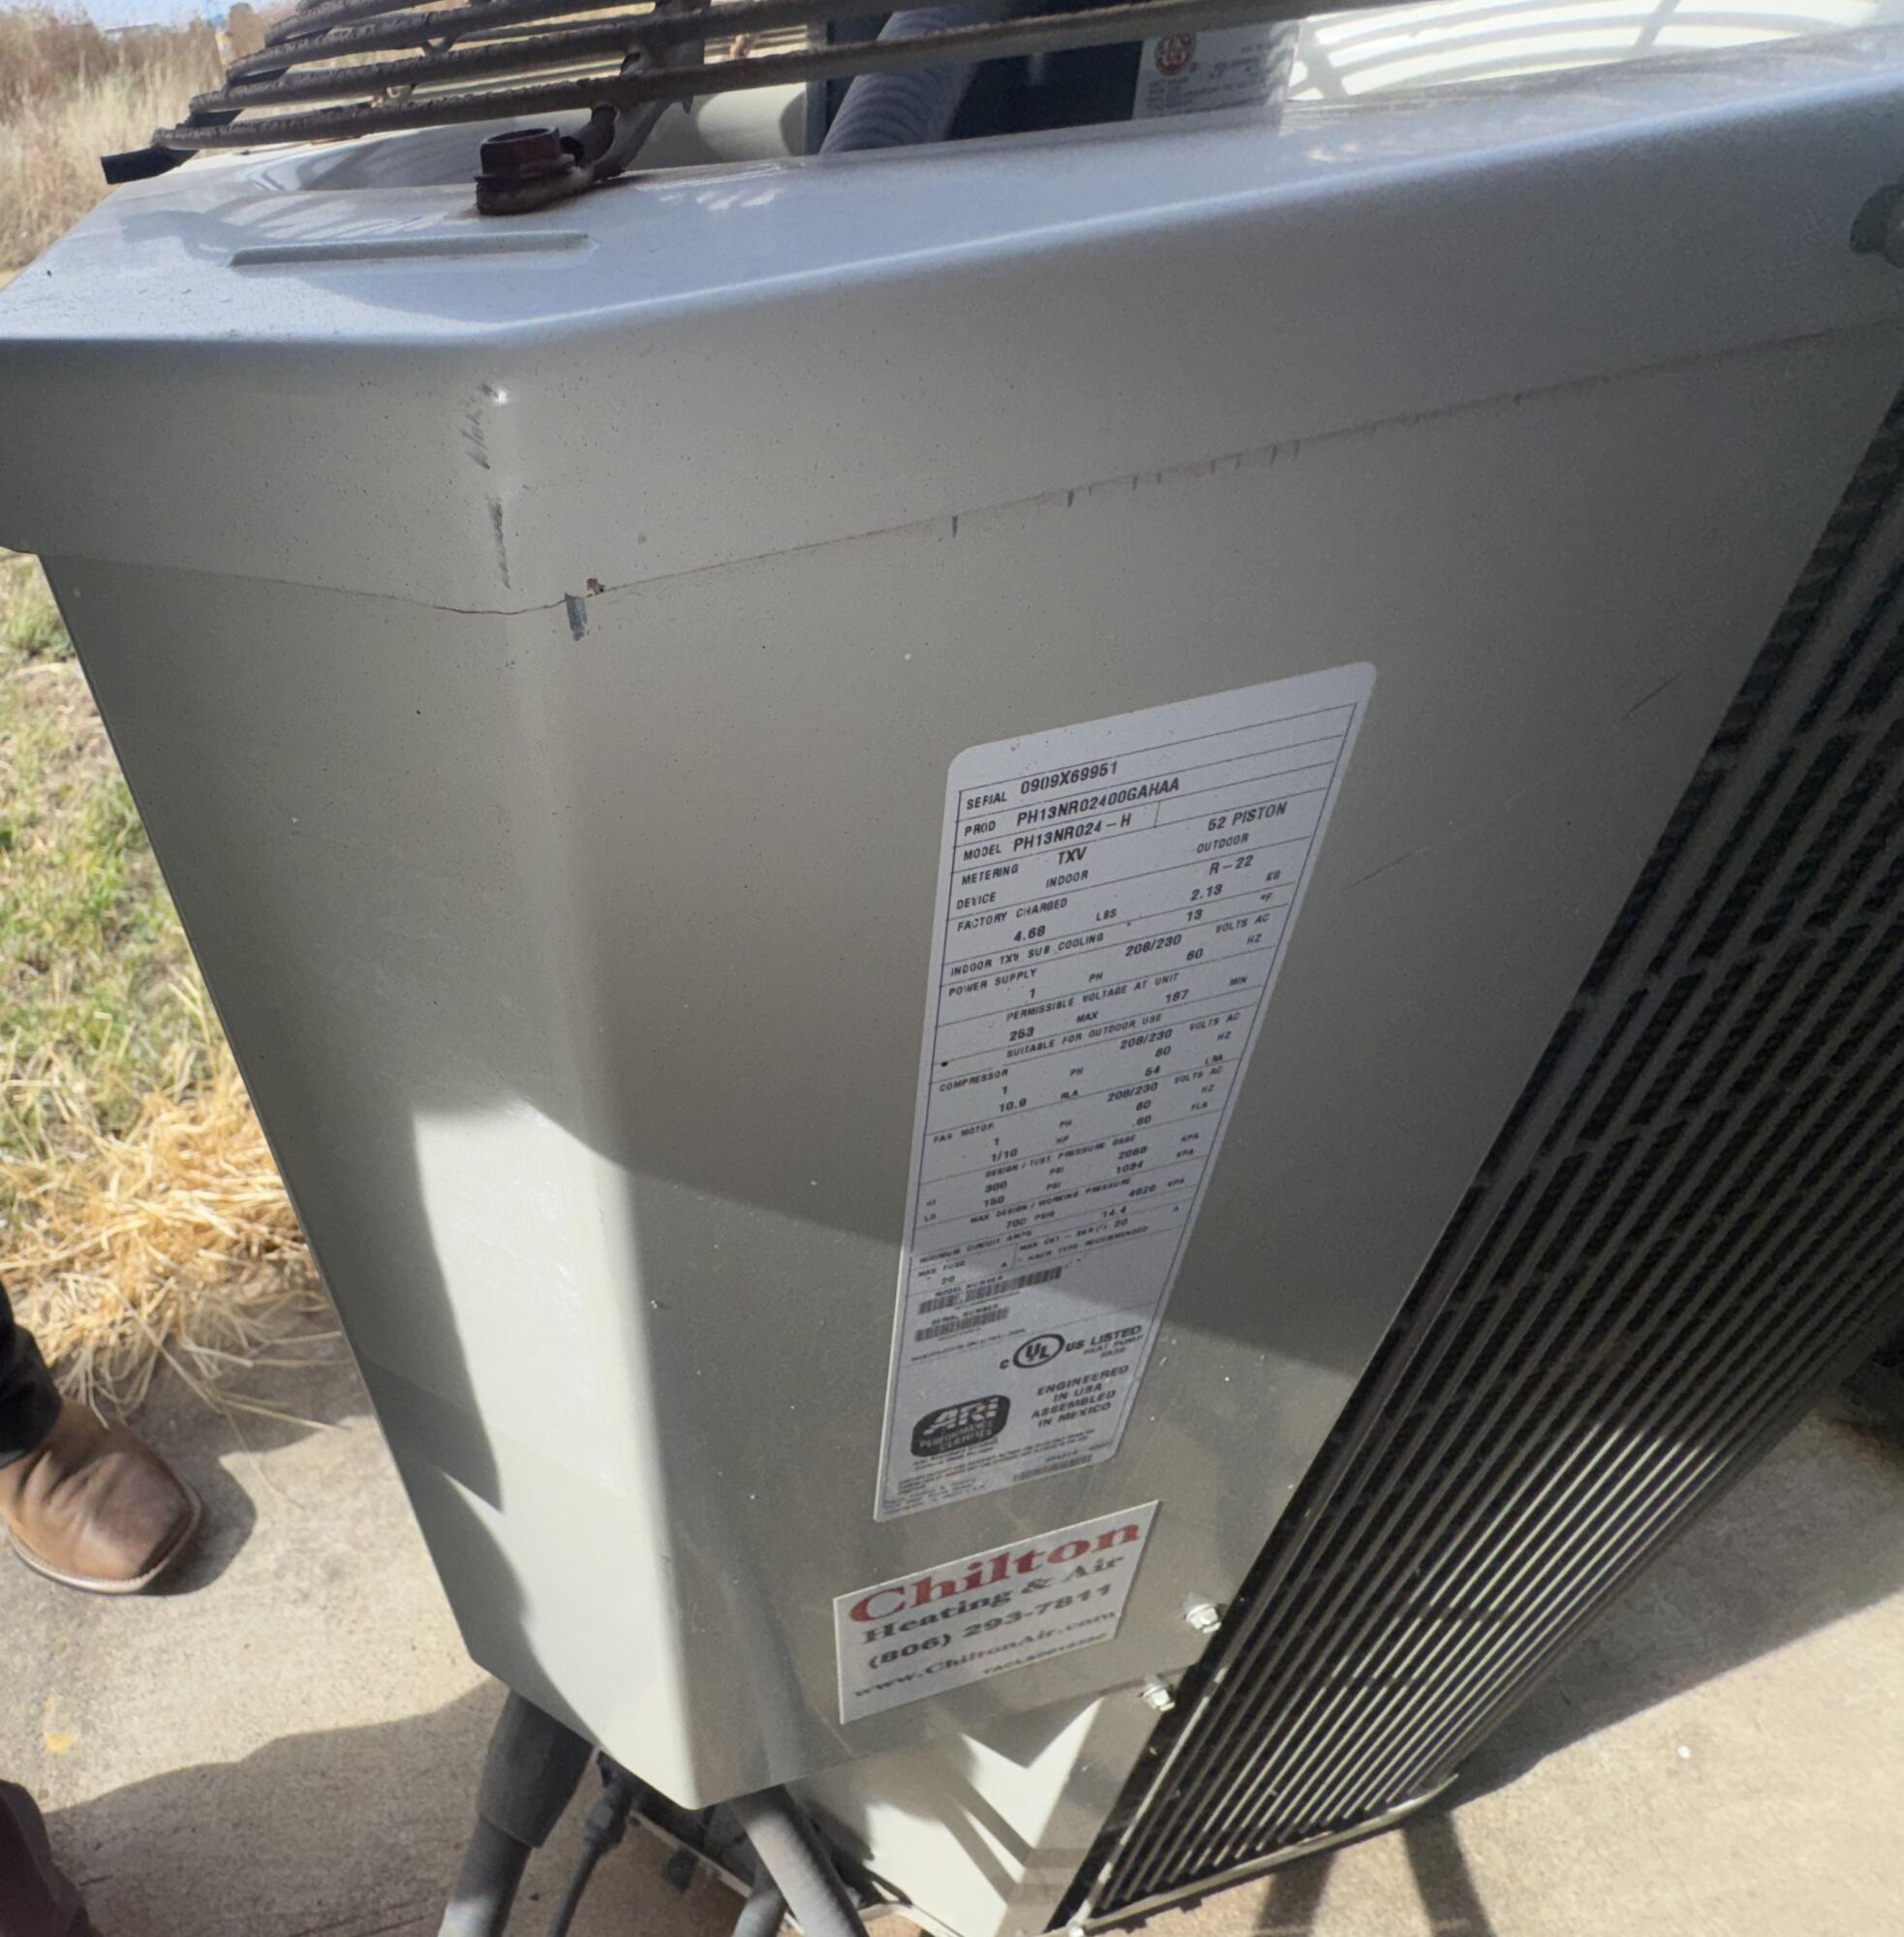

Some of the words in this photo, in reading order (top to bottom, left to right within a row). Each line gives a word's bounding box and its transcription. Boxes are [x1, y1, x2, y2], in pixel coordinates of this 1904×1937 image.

[965, 820, 996, 837] PROD
[1017, 777, 1180, 826] PH13NR02400GAHAA
[967, 791, 1007, 810] SERIAL
[1021, 761, 1118, 794] 0909X69951
[957, 892, 997, 909] DEVICE
[1046, 870, 1089, 888] INDOOR
[1196, 833, 1249, 853] OUTDOOR
[962, 864, 1019, 885] METERING
[1058, 846, 1088, 865] TXV
[1208, 816, 1226, 832] 52
[1232, 801, 1288, 826] PISTON
[964, 844, 1001, 861] MODEL
[957, 911, 1007, 932] FACTORY
[1016, 898, 1068, 917] CHARGED
[1013, 925, 1046, 942] 4.68
[1096, 908, 1117, 921] LBS
[1190, 884, 1223, 901] 2.13
[1266, 870, 1280, 881] KG
[949, 978, 988, 997] POWER
[995, 968, 1037, 986] SUPPLY
[1125, 934, 1182, 957] 208/230
[1215, 917, 1247, 934] VOLTS
[1255, 913, 1270, 925] AC
[951, 960, 992, 976] INDOOR
[999, 953, 1020, 966] TXV
[1028, 945, 1050, 959] SUB
[1058, 933, 1104, 951] COOLING
[1187, 908, 1203, 921] 13
[1029, 988, 1035, 999] 1
[1089, 971, 1103, 983] PH
[1186, 948, 1204, 961] 60
[1247, 934, 1262, 944] HZ
[1006, 999, 1074, 1021] PERMISSIBLE
[1083, 985, 1127, 1002] VOLTAGE
[1134, 980, 1148, 991] AT
[1154, 972, 1180, 986] UNIT
[1009, 1027, 1034, 1042] 253
[1076, 1011, 1099, 1024] MAX
[1165, 989, 1189, 1003] 187
[1229, 975, 1247, 986] MIN
[939, 1069, 1008, 1092] COMPRESSOR
[1120, 1029, 1173, 1050] 208/230
[1189, 1018, 1218, 1031] VOLTS
[1226, 1012, 1240, 1024] AC
[1001, 1086, 1008, 1094] 1
[1069, 1067, 1083, 1077] PH
[1155, 1046, 1172, 1058] 60
[1217, 1030, 1231, 1041] HZ
[1006, 1039, 1055, 1058] SUITABLE
[1061, 1032, 1082, 1045] FOR
[1089, 1020, 1136, 1038] OUTDOOR
[1142, 1014, 1162, 1026] USE
[961, 1122, 995, 1137] MOTOR
[1107, 1082, 1158, 1102] 208/230
[1174, 1071, 1204, 1085] VOLTS
[1210, 1065, 1223, 1076] AC
[1145, 1065, 1160, 1077] 54
[994, 1137, 999, 1146] 1
[1135, 1099, 1152, 1111] 60
[1201, 1084, 1215, 1094] HZ
[992, 1148, 1018, 1162] 1/10
[1058, 1142, 1106, 1159] PRESSURE
[1085, 1178, 1131, 1194] PRESSURE
[1065, 1339, 1085, 1352] US
[1090, 1325, 1142, 1345] LISTED
[1030, 1390, 1116, 1419] ASSEMBLED
[1037, 1365, 1129, 1396] ENGINEERED
[1054, 1392, 1068, 1402] IN
[1074, 1383, 1102, 1398] USA
[1038, 1418, 1052, 1428] IN
[1058, 1402, 1112, 1422] MEXICO
[849, 1523, 1141, 1623] Chilton
[863, 1590, 1013, 1644] Heating
[1022, 1578, 1052, 1595] &
[1063, 1556, 1124, 1582] Air
[855, 1612, 1116, 1696] www.ChiltonAir.com
[868, 1634, 951, 1670] (806)
[964, 1583, 1111, 1638] 293-7811
